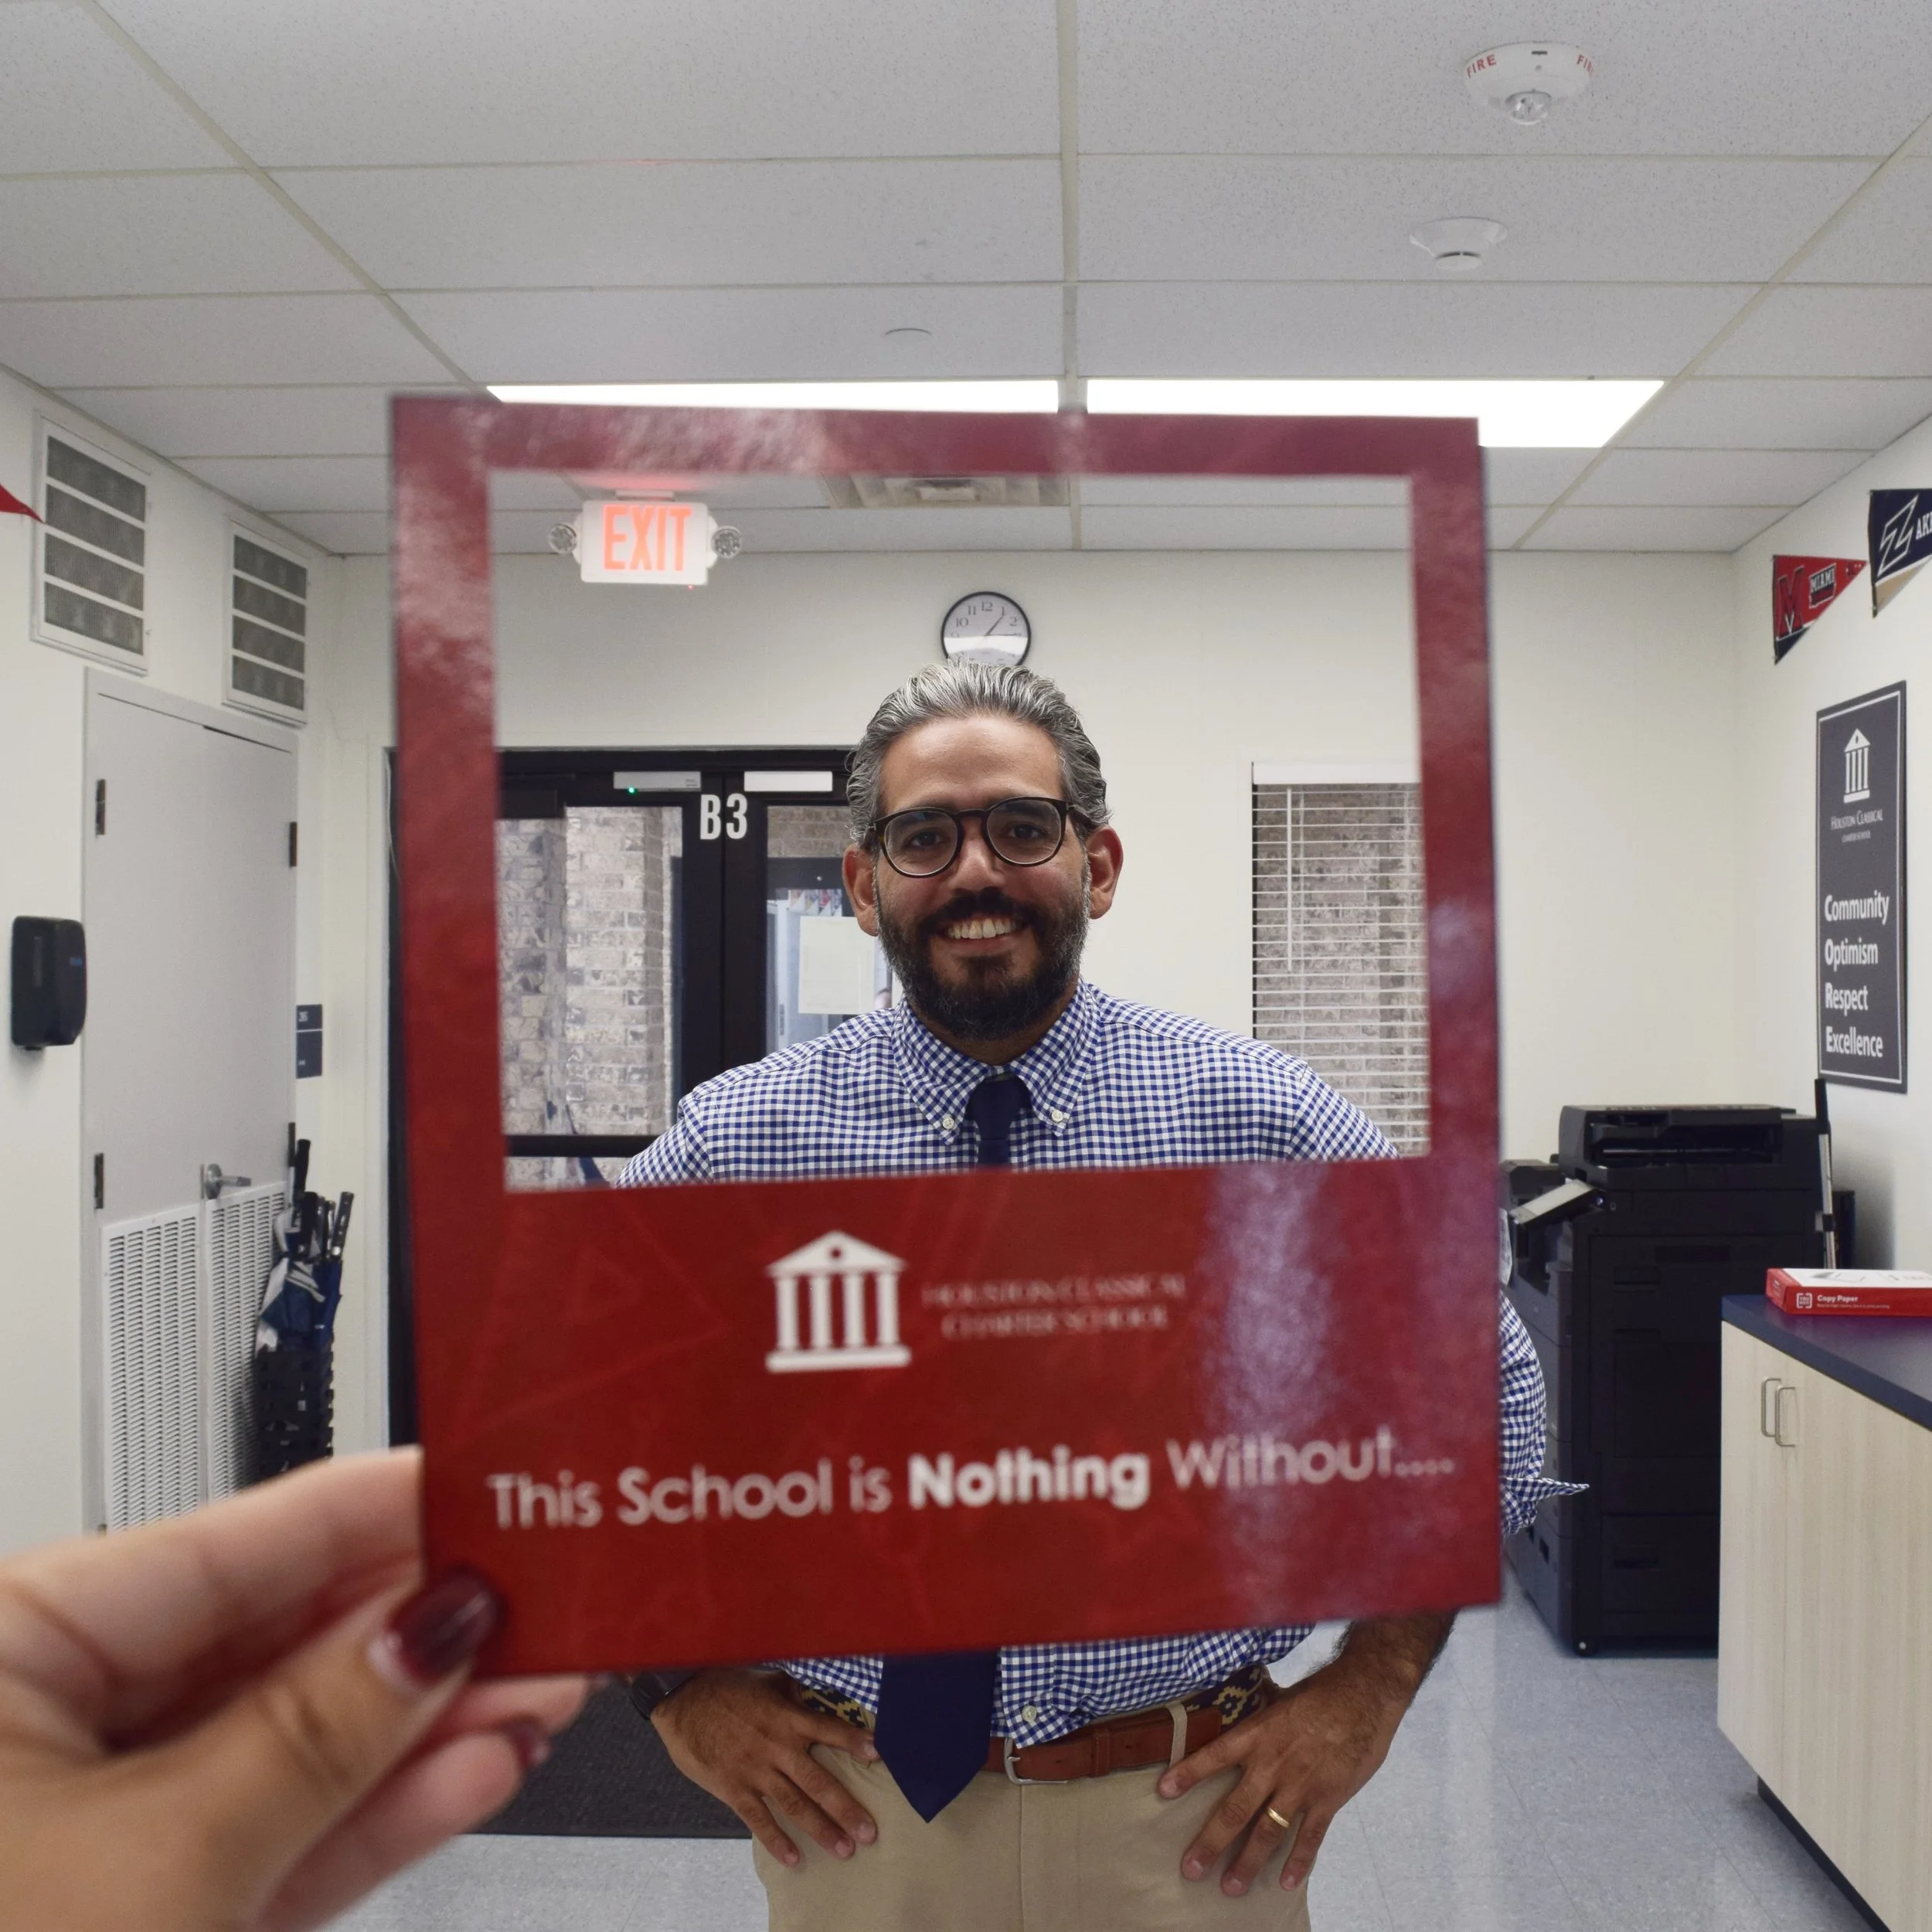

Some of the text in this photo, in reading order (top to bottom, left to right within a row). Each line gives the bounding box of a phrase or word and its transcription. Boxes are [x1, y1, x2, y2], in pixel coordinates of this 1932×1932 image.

[1467, 54, 1497, 78] FIRE
[1577, 54, 1594, 75] FIR
[603, 504, 692, 571] EXIT
[1811, 568, 1835, 594] MIAMI
[968, 605, 976, 615] 11
[981, 601, 993, 611] 12
[955, 617, 969, 628] 10
[1009, 617, 1017, 626] 2
[699, 793, 748, 840] B3
[1825, 890, 1889, 925] Community
[1825, 938, 1879, 971] Optimism
[1825, 982, 1869, 1016] Respect
[1825, 1026, 1883, 1057] Excellence
[1817, 1294, 1859, 1304] Copy Paper
[487, 1468, 603, 1529] This
[617, 1458, 833, 1526] School
[849, 1455, 894, 1512] is
[907, 1444, 1151, 1509] Nothing
